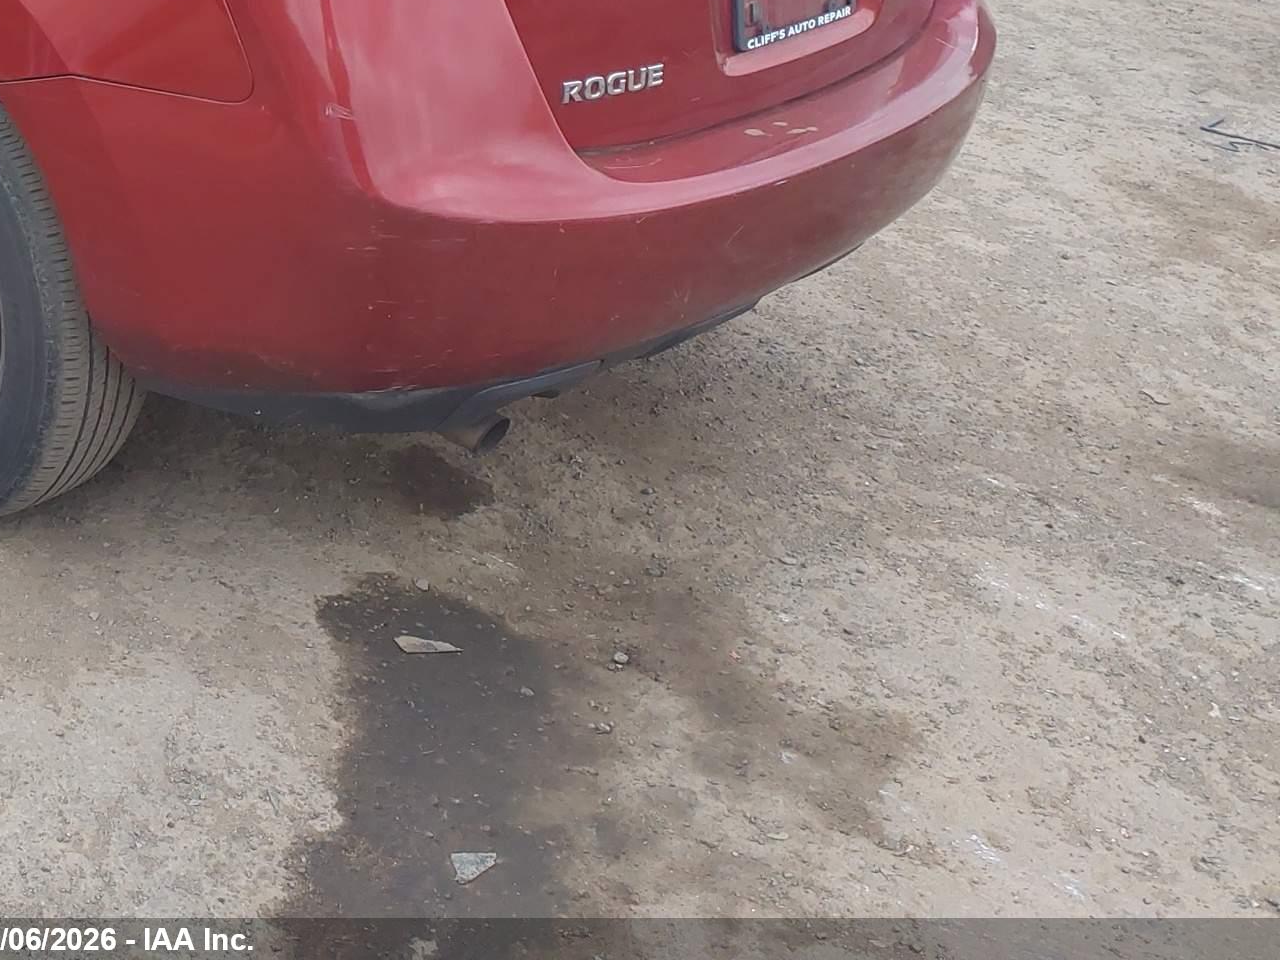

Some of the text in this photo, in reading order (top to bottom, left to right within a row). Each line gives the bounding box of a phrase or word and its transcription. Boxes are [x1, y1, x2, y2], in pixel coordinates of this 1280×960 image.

[747, 6, 852, 50] CLIFF'S AUTO REPAIR
[562, 63, 664, 105] ROGUE
